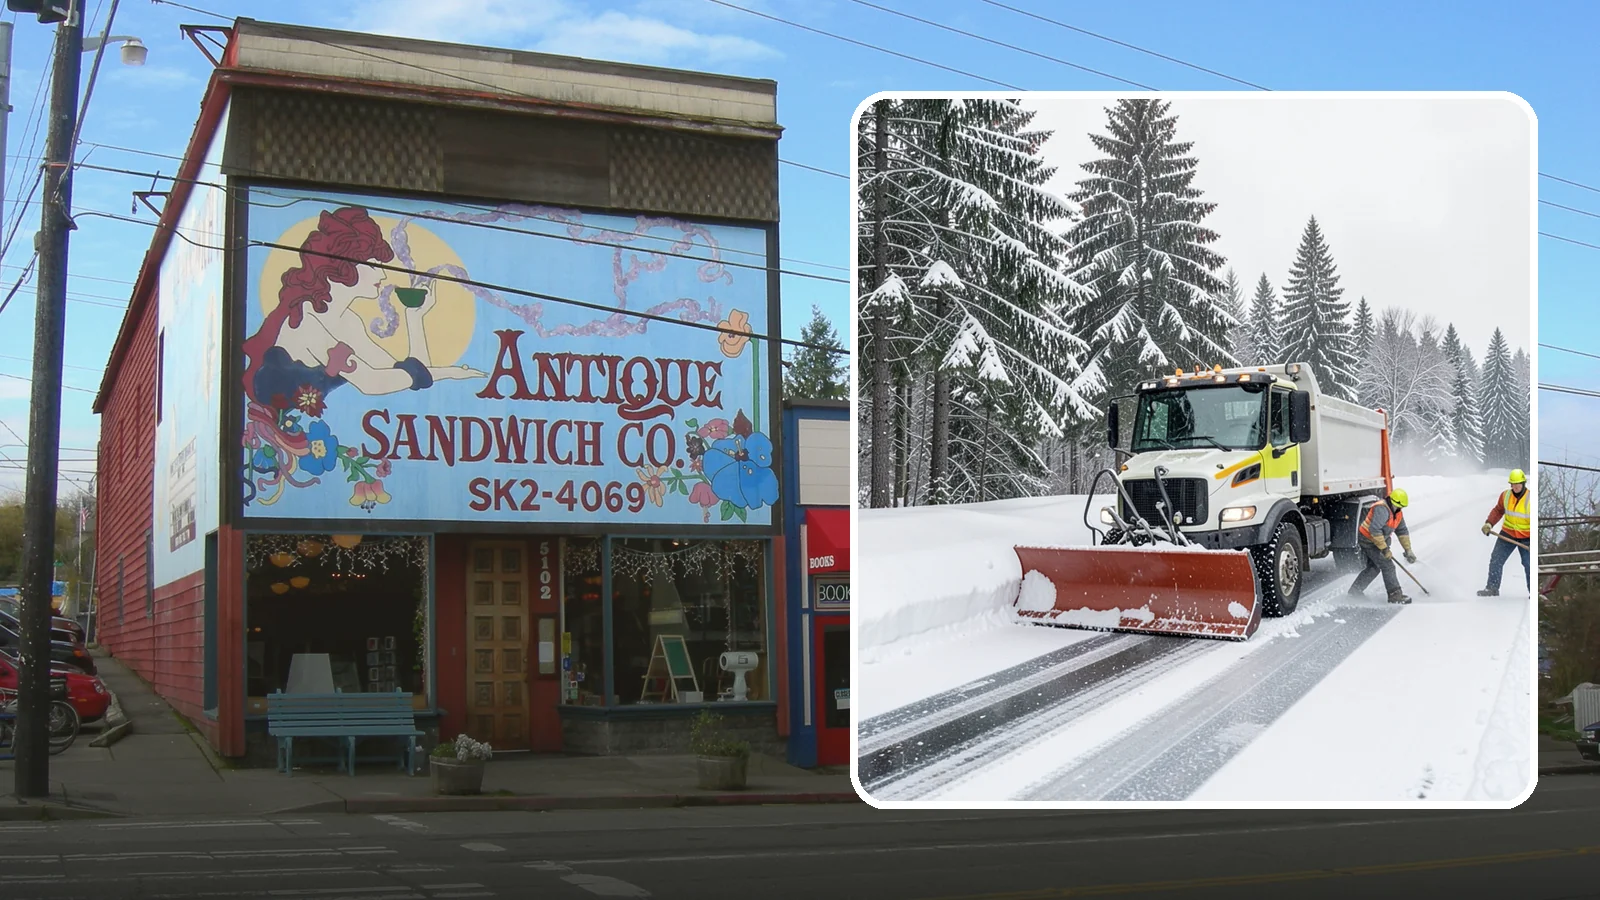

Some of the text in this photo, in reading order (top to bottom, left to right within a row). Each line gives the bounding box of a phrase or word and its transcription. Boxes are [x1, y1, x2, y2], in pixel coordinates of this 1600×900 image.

[476, 329, 724, 421] ANTIQUE
[361, 408, 685, 469] SANDWICH CO.
[468, 477, 646, 513] SK2-4069
[539, 541, 552, 600] 5102
[809, 555, 835, 569] BOOKS
